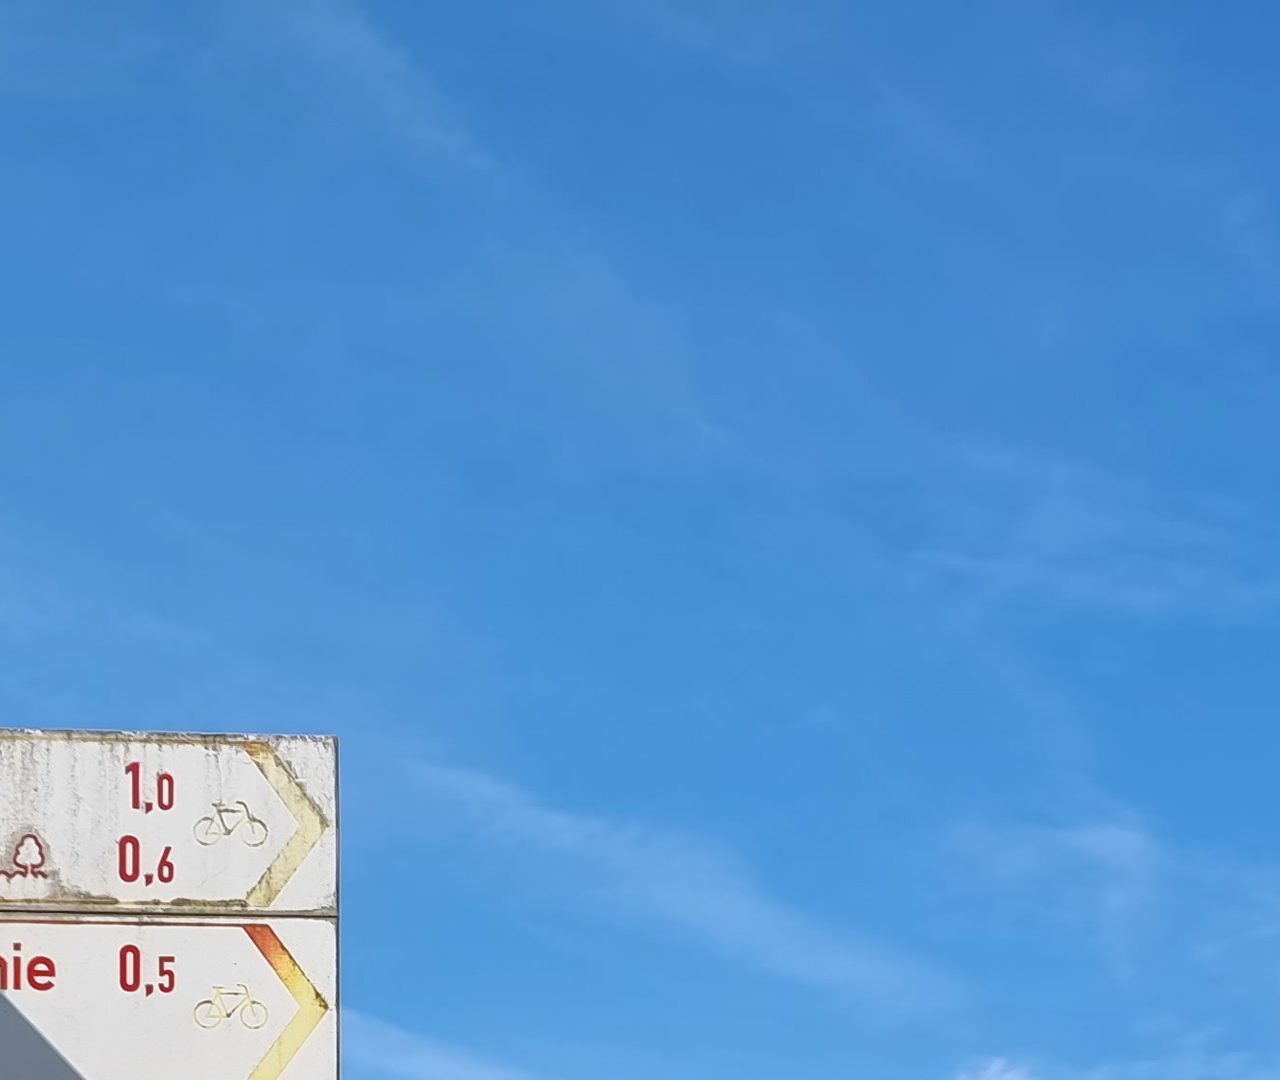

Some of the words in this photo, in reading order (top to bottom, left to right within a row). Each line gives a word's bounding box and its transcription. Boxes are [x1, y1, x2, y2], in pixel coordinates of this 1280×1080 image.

[125, 762, 174, 814] 1,0
[118, 835, 174, 886] 0,6
[119, 944, 175, 997] 0,5
